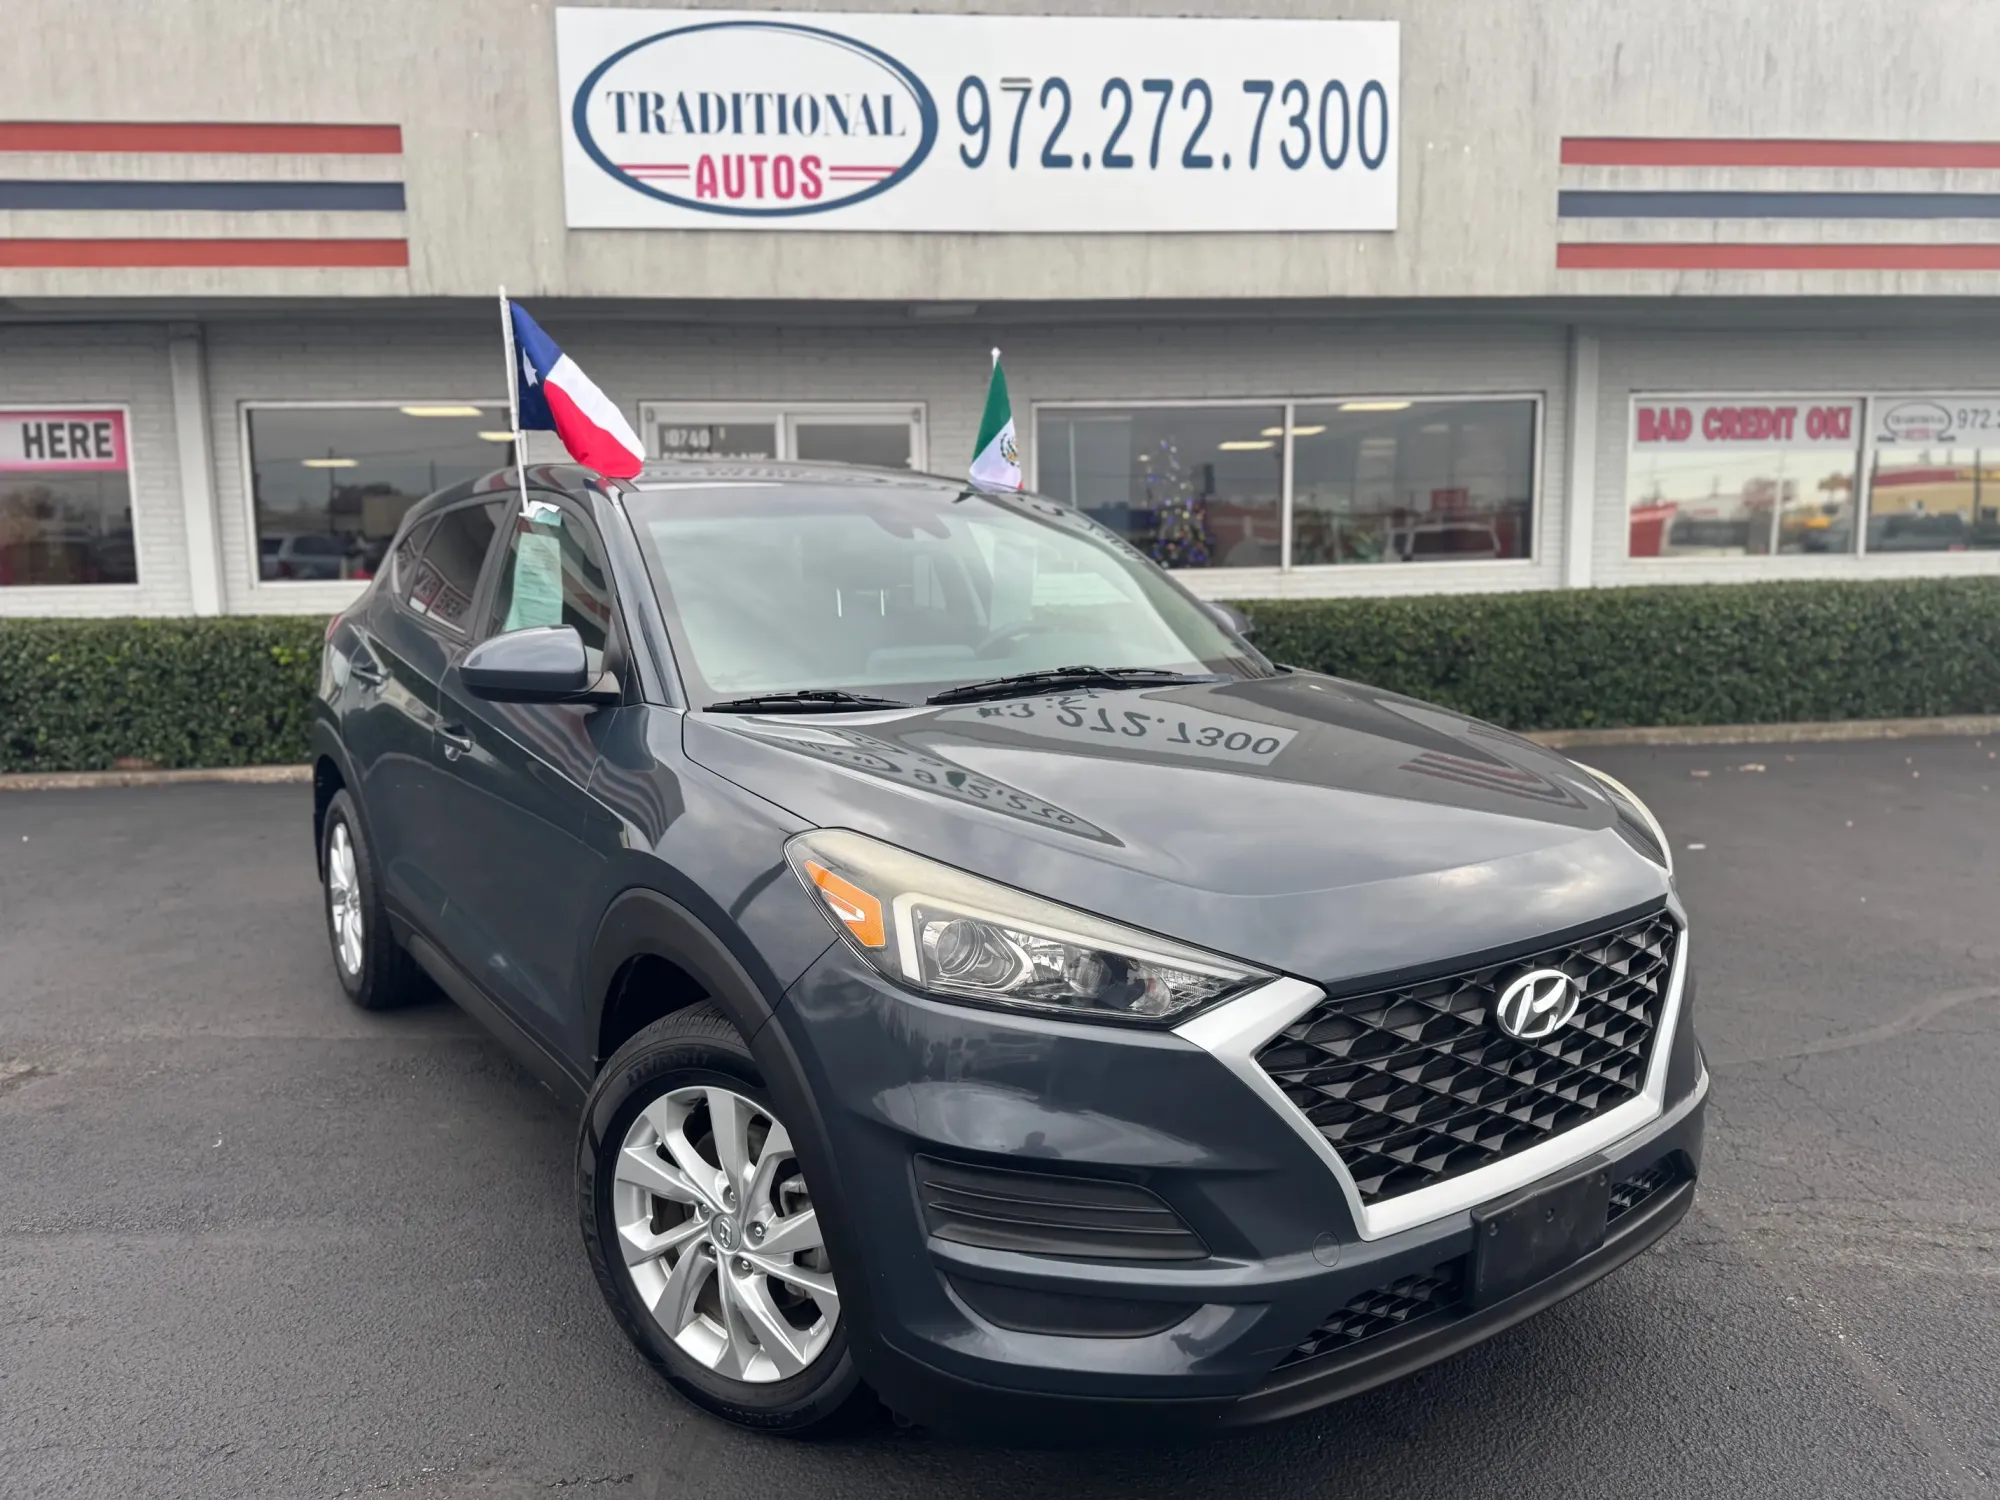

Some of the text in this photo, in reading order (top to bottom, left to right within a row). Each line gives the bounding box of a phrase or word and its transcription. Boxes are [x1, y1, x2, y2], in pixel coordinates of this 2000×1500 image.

[606, 90, 906, 137] TRADITIONAL
[956, 75, 1389, 170] 972.272.7300
[696, 153, 823, 200] AUTOS
[22, 421, 114, 460] HERE
[663, 428, 711, 448] 10740
[1637, 407, 1693, 442] BAD
[1702, 406, 1798, 441] CREDIT
